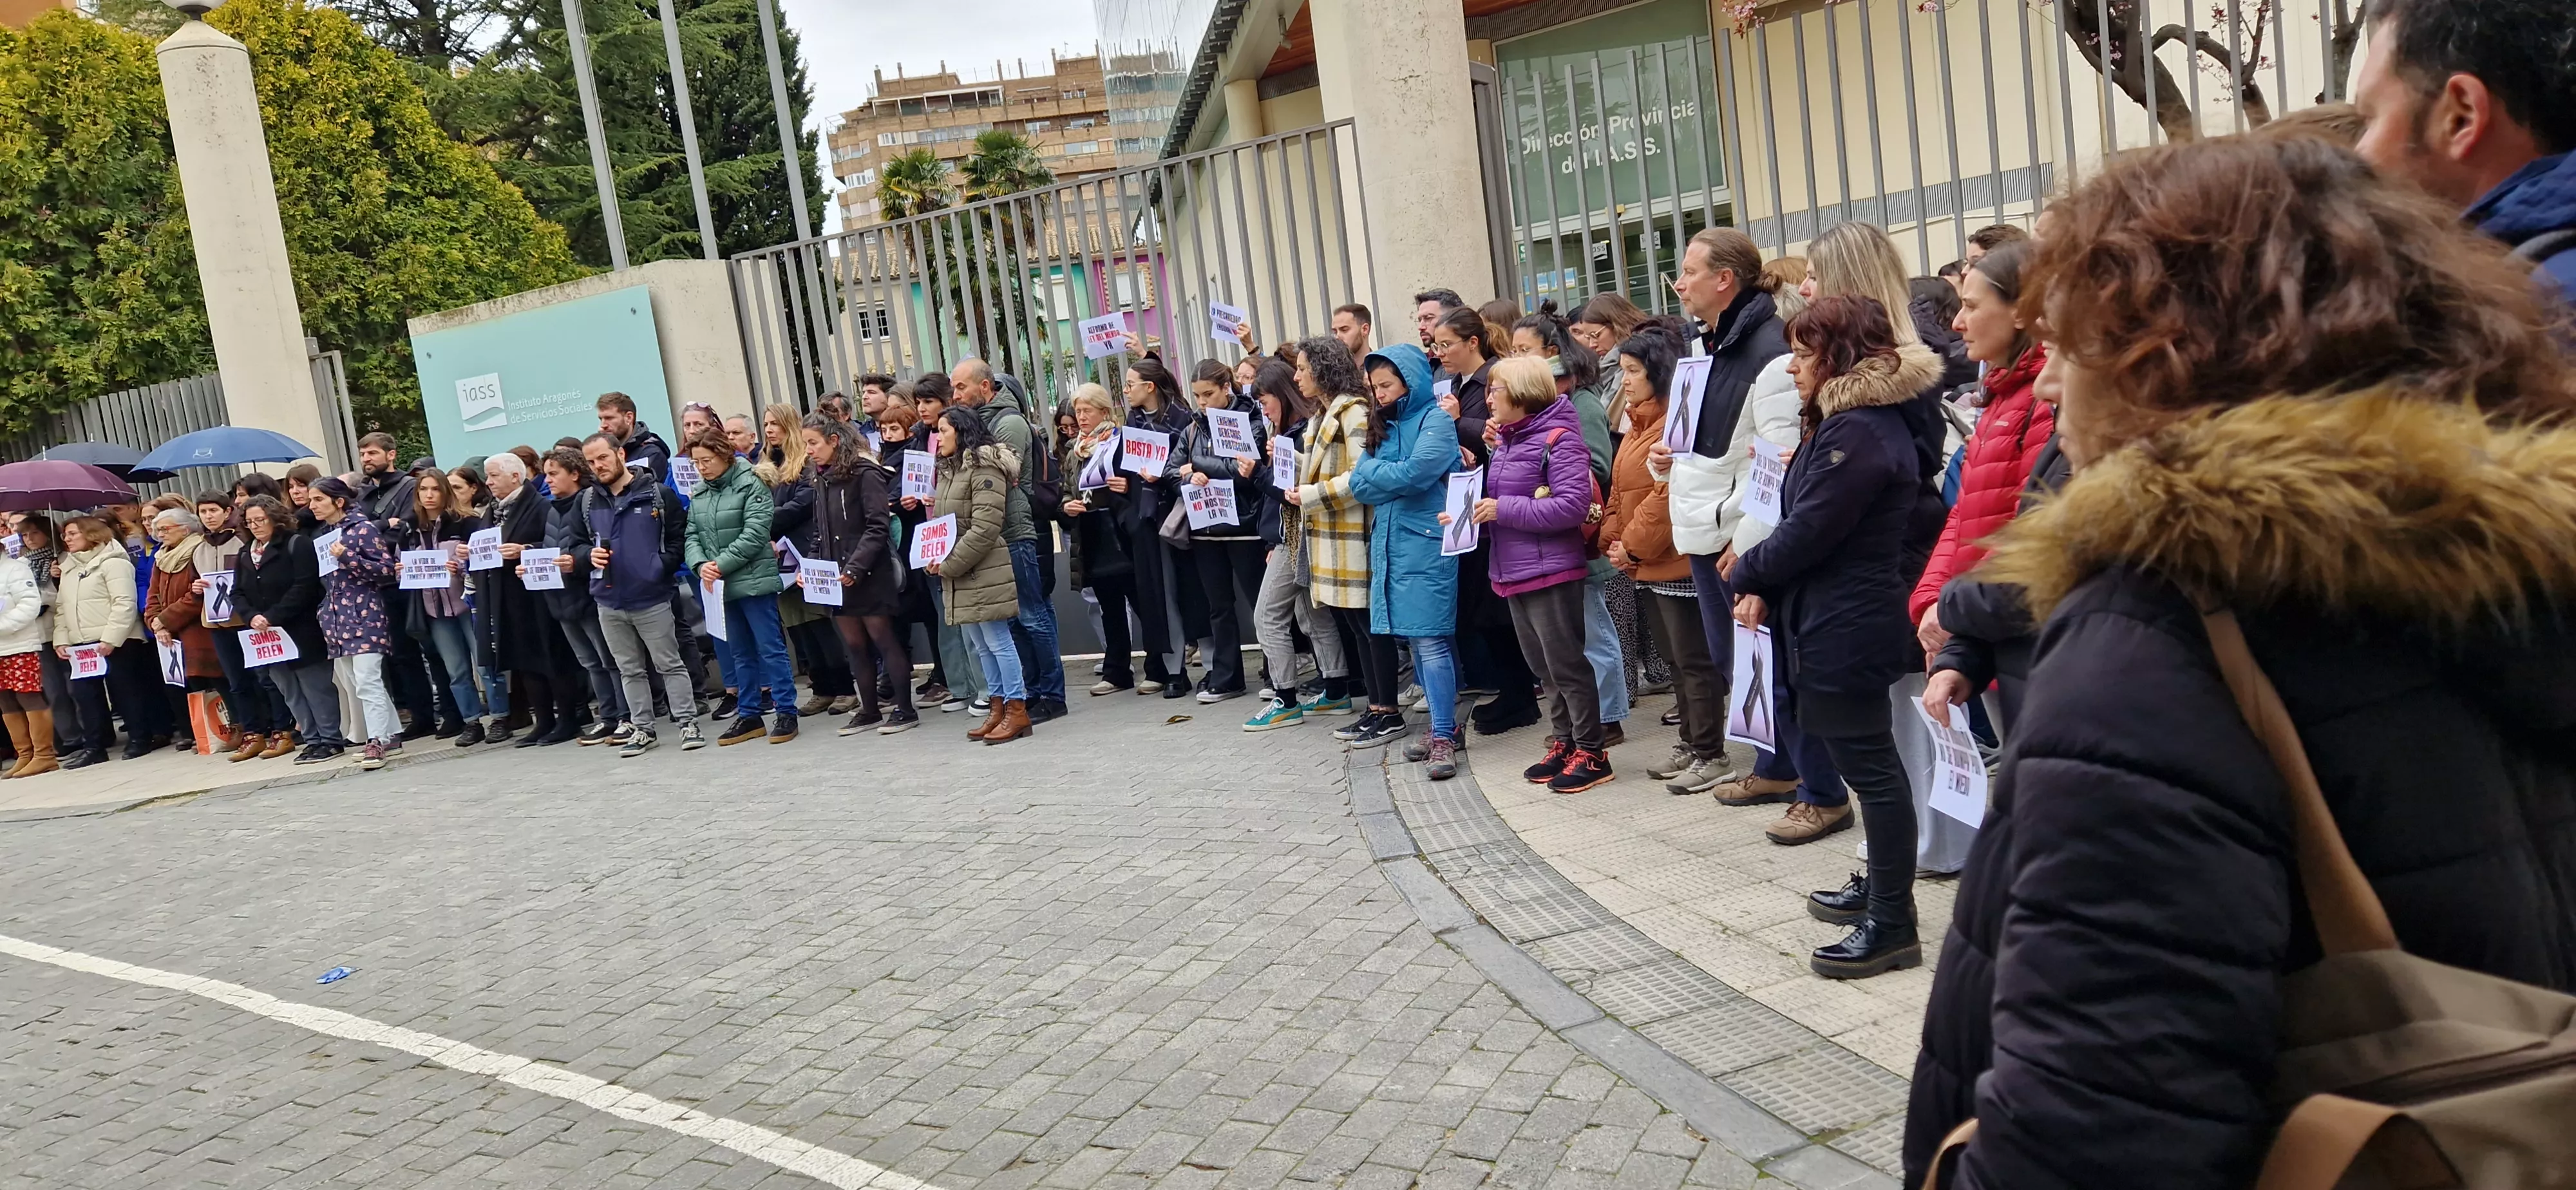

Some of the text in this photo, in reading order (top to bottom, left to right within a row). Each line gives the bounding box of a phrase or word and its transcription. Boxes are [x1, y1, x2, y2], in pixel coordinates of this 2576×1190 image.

[1562, 152, 1588, 174] dl
[1088, 323, 1108, 334] REFORMA
[1104, 330, 1121, 339] MENOR
[1103, 340, 1113, 350] YA
[462, 384, 495, 402] iass
[507, 388, 581, 411] Instituto Aragonés
[511, 401, 593, 424] de Servicios Sociales
[1126, 439, 1166, 462] BASTA YA
[1188, 489, 1203, 501] QUE
[1204, 486, 1212, 497] EL
[1193, 501, 1202, 512] NO
[1204, 497, 1218, 508] NOS
[1208, 509, 1217, 519] LA
[921, 522, 947, 542] SOMOS
[921, 539, 945, 558] BELÉN
[249, 630, 281, 645] SOMOS
[75, 648, 97, 660] SOMOS
[256, 643, 283, 659] BELÉN
